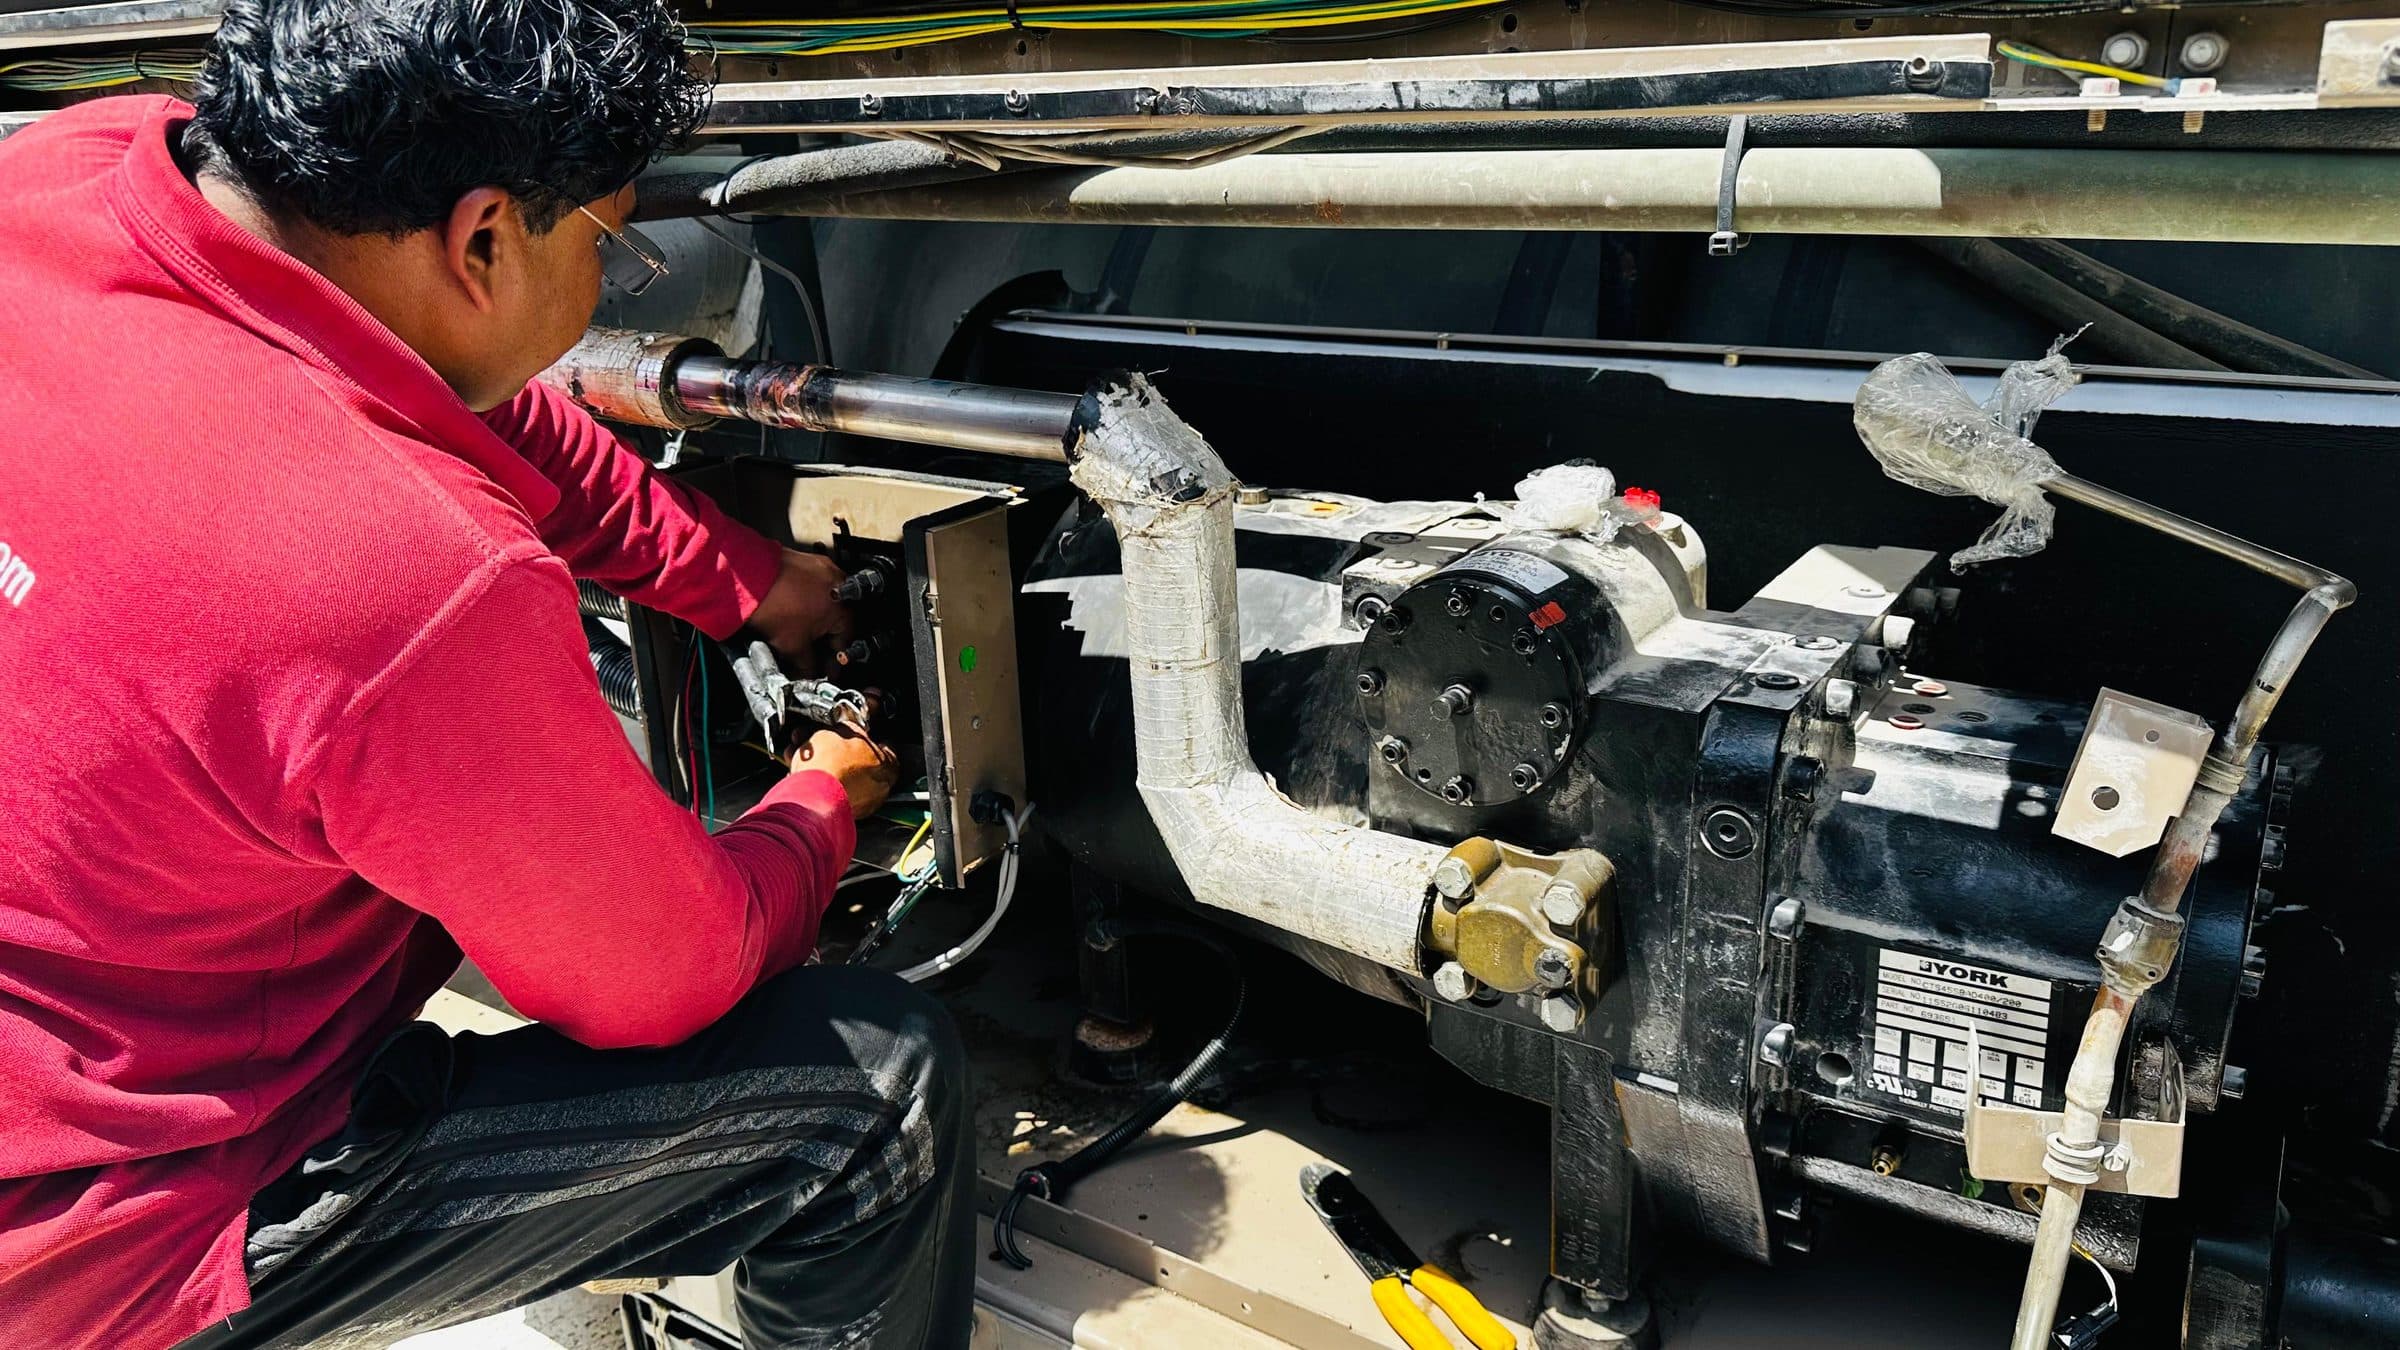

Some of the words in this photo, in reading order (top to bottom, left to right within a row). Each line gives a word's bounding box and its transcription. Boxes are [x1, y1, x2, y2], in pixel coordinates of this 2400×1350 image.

[1883, 972, 1906, 983] MODEL
[1931, 963, 2009, 988] YORK
[1882, 986, 1906, 998] SERIAL
[1881, 1001, 1899, 1011] PART
